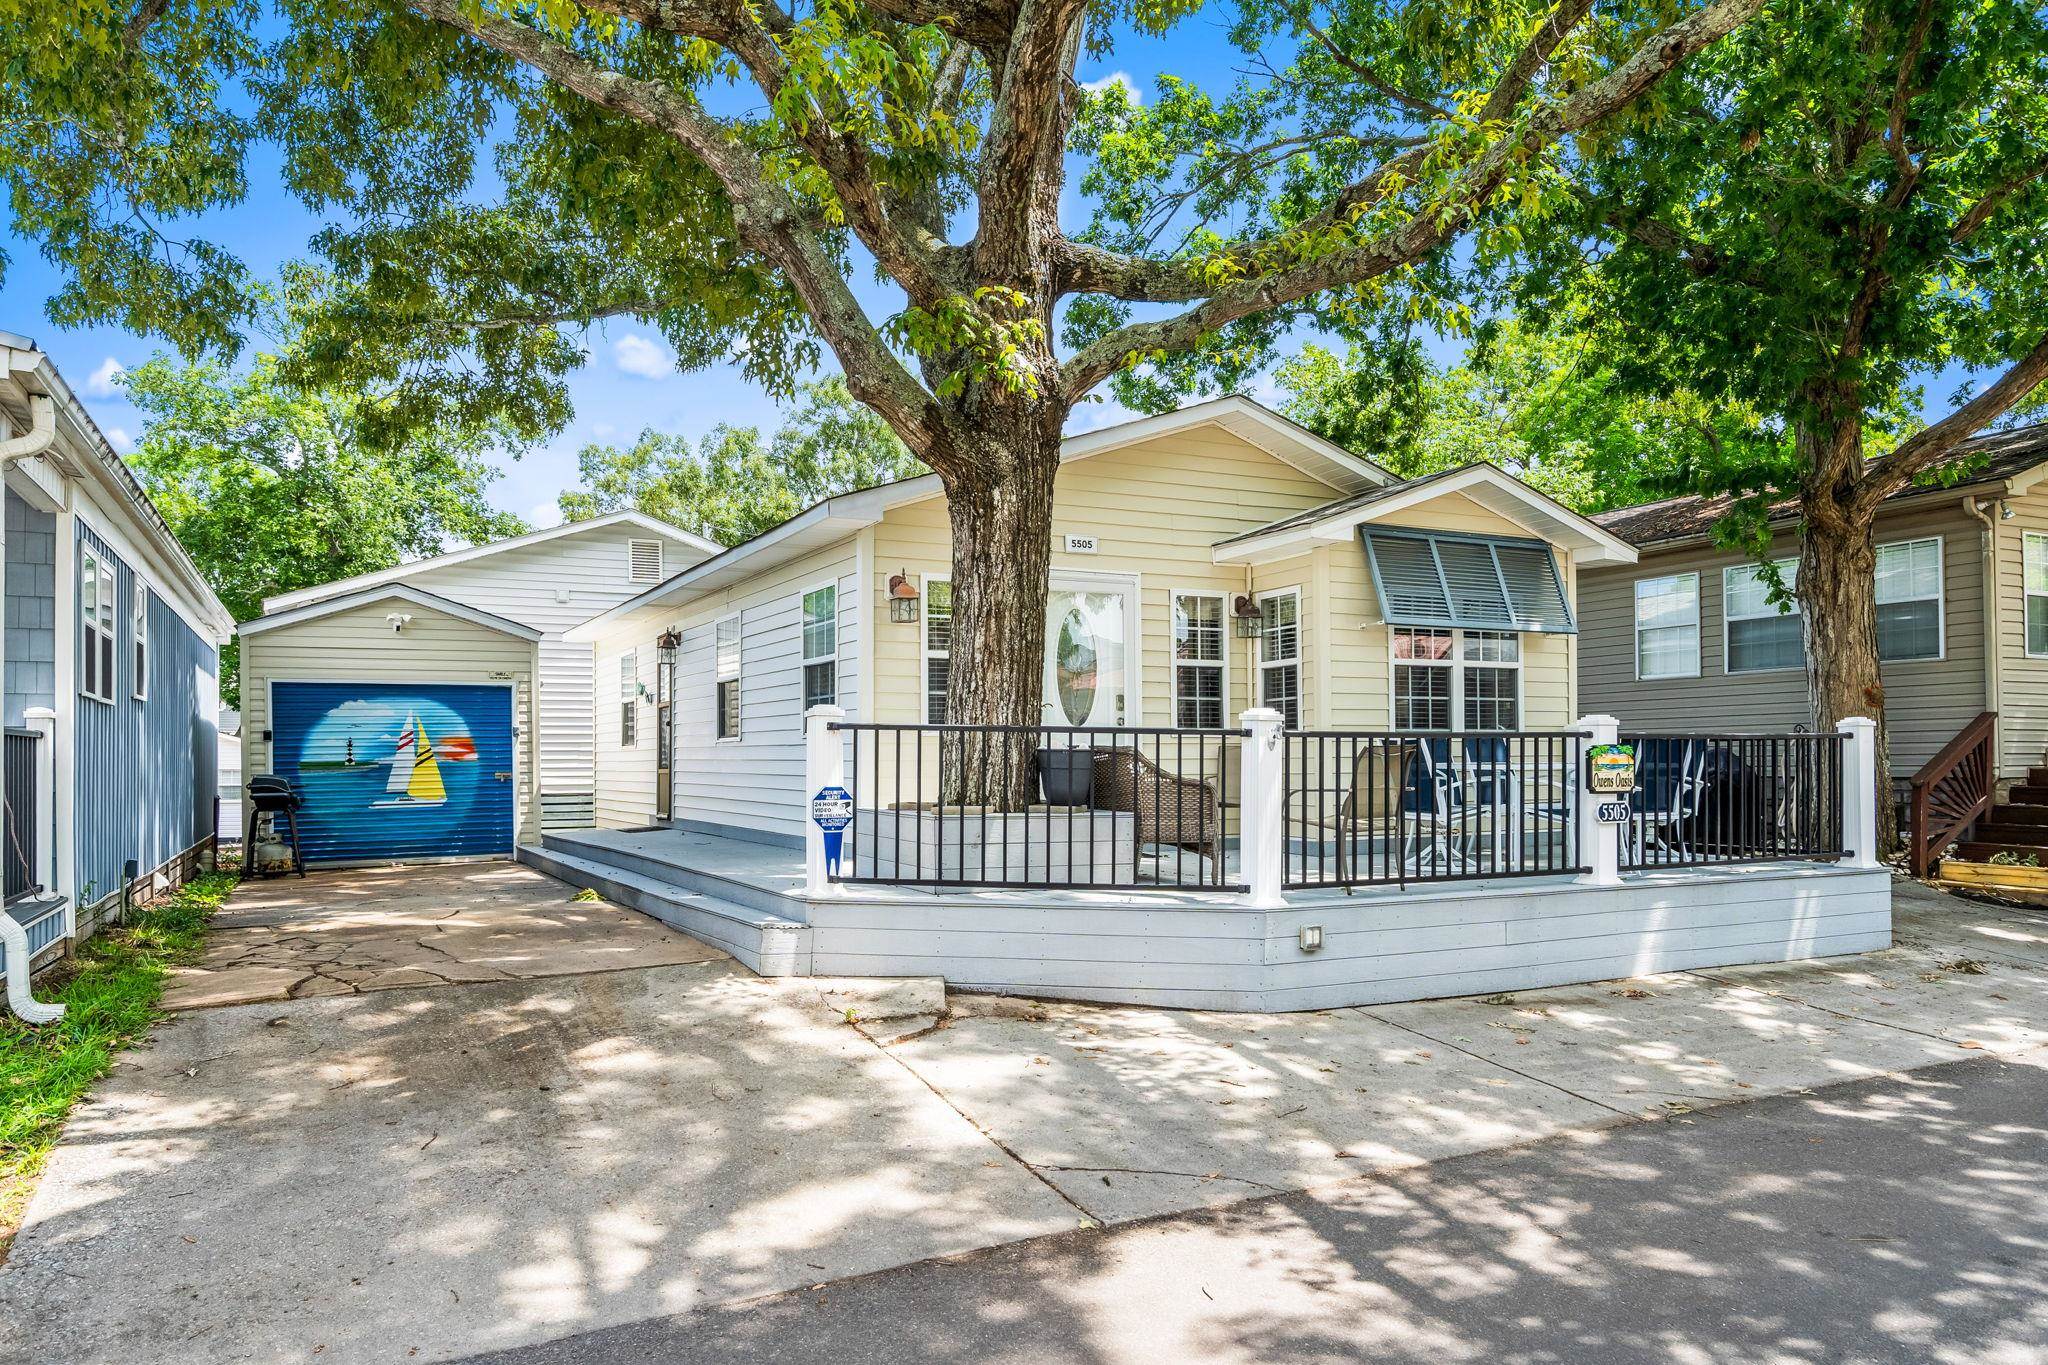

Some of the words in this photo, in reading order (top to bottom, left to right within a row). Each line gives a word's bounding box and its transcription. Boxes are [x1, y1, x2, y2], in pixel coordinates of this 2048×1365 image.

[1071, 539, 1093, 549] 5505
[1593, 772, 1614, 788] Owens
[1615, 772, 1633, 788] Oasis
[1601, 804, 1626, 821] 5505
